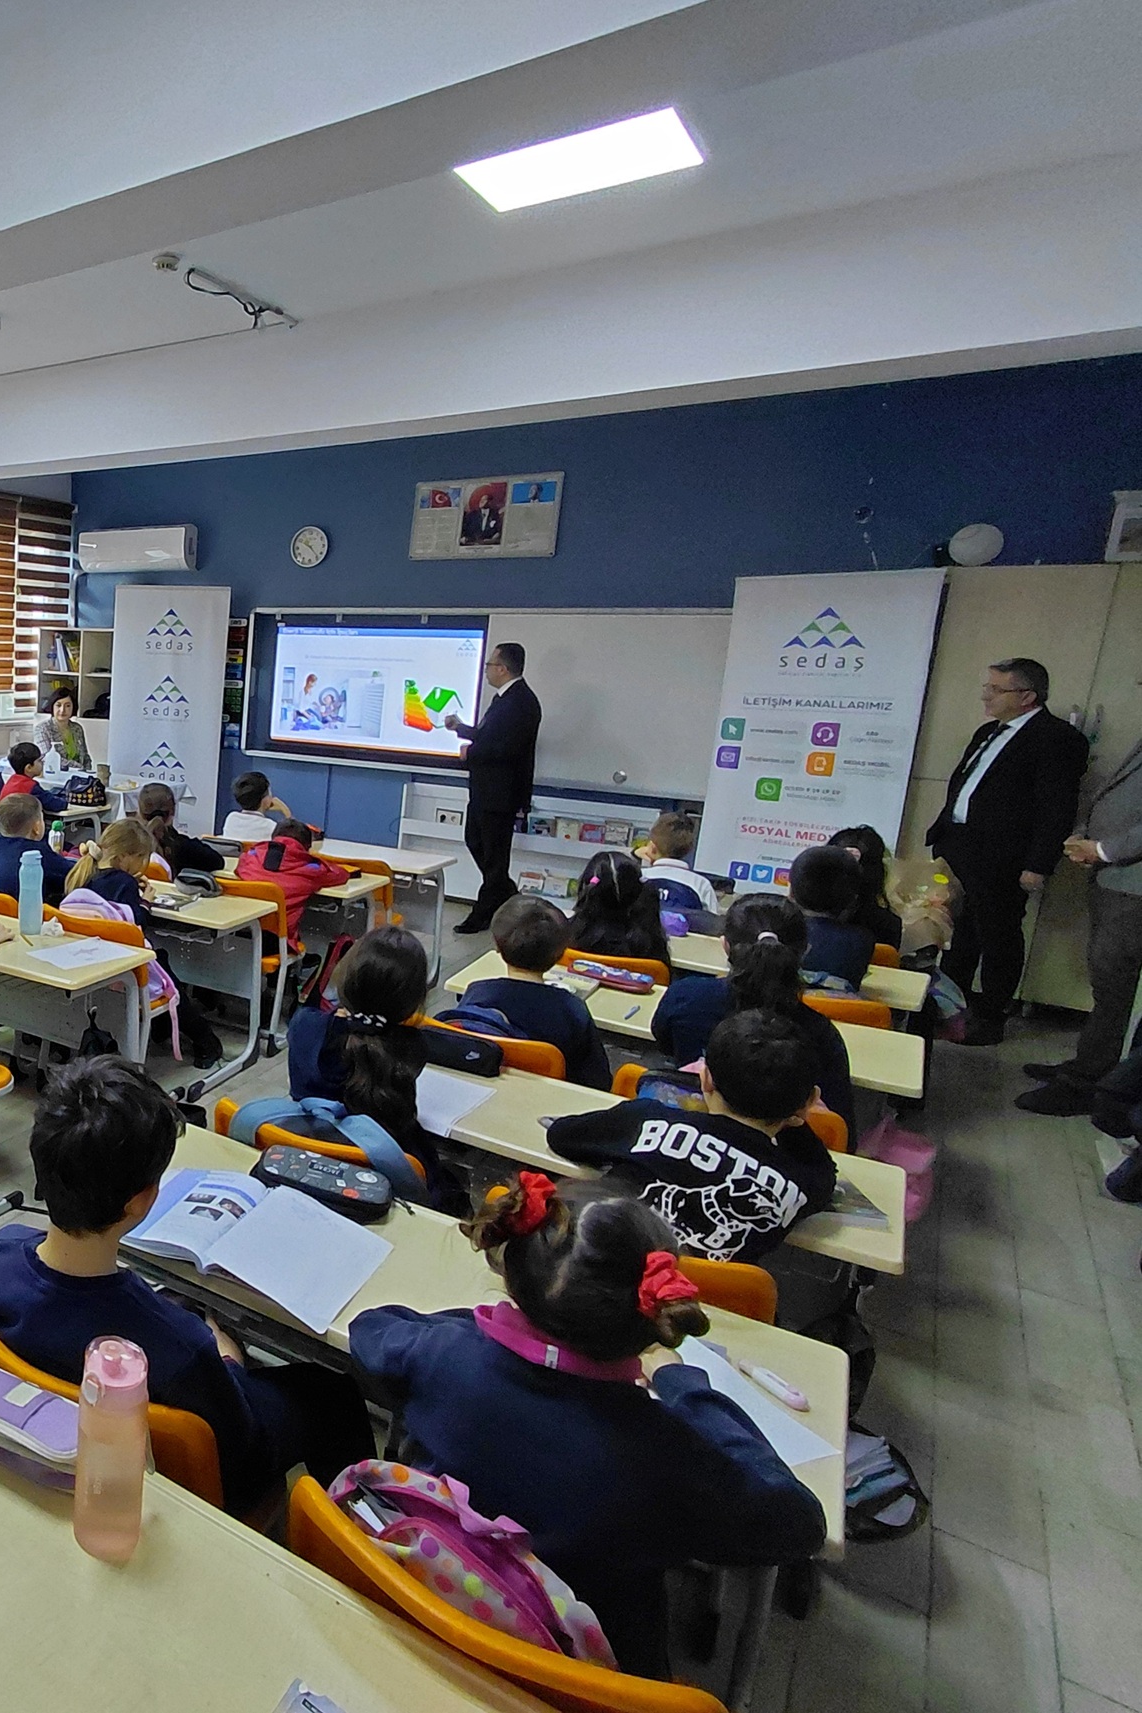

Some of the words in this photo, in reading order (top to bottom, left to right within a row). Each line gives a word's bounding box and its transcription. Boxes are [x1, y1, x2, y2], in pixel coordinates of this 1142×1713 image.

[145, 639, 193, 653] sedaş
[778, 652, 865, 673] sedaş
[742, 695, 792, 708] İLETİŞİM
[795, 699, 893, 711] KANALLARIMIZ
[142, 706, 190, 719] sedaş
[740, 824, 791, 838] SOSYAL
[630, 1119, 807, 1228] BOSTON
